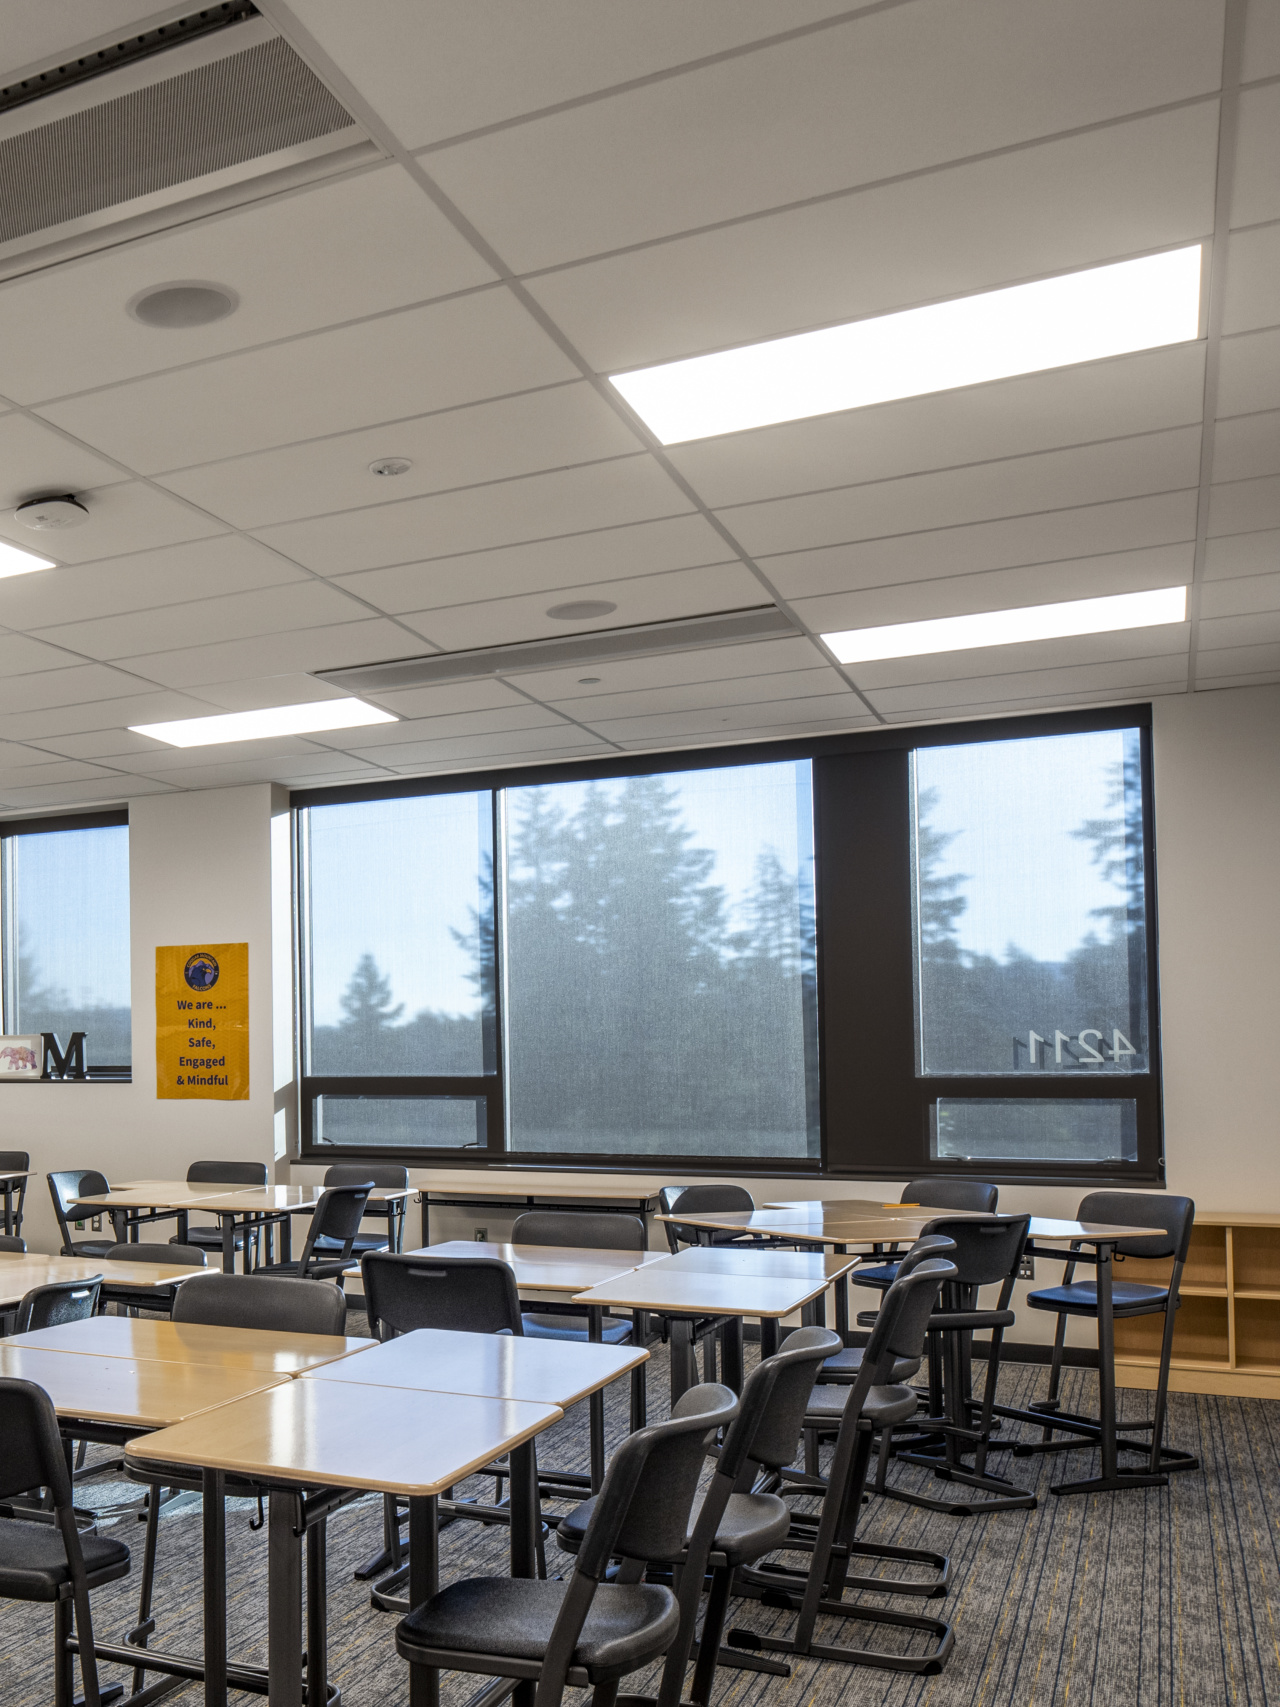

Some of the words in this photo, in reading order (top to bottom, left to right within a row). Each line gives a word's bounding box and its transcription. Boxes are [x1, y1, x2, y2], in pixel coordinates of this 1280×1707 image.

[177, 1000, 193, 1010] We
[195, 1001, 213, 1010] are
[188, 1018, 216, 1031] Kind,
[188, 1036, 216, 1050] Safe,
[40, 1031, 89, 1079] M
[179, 1056, 225, 1069] Engaged
[176, 1075, 185, 1086] &
[187, 1075, 229, 1086] Mindful
